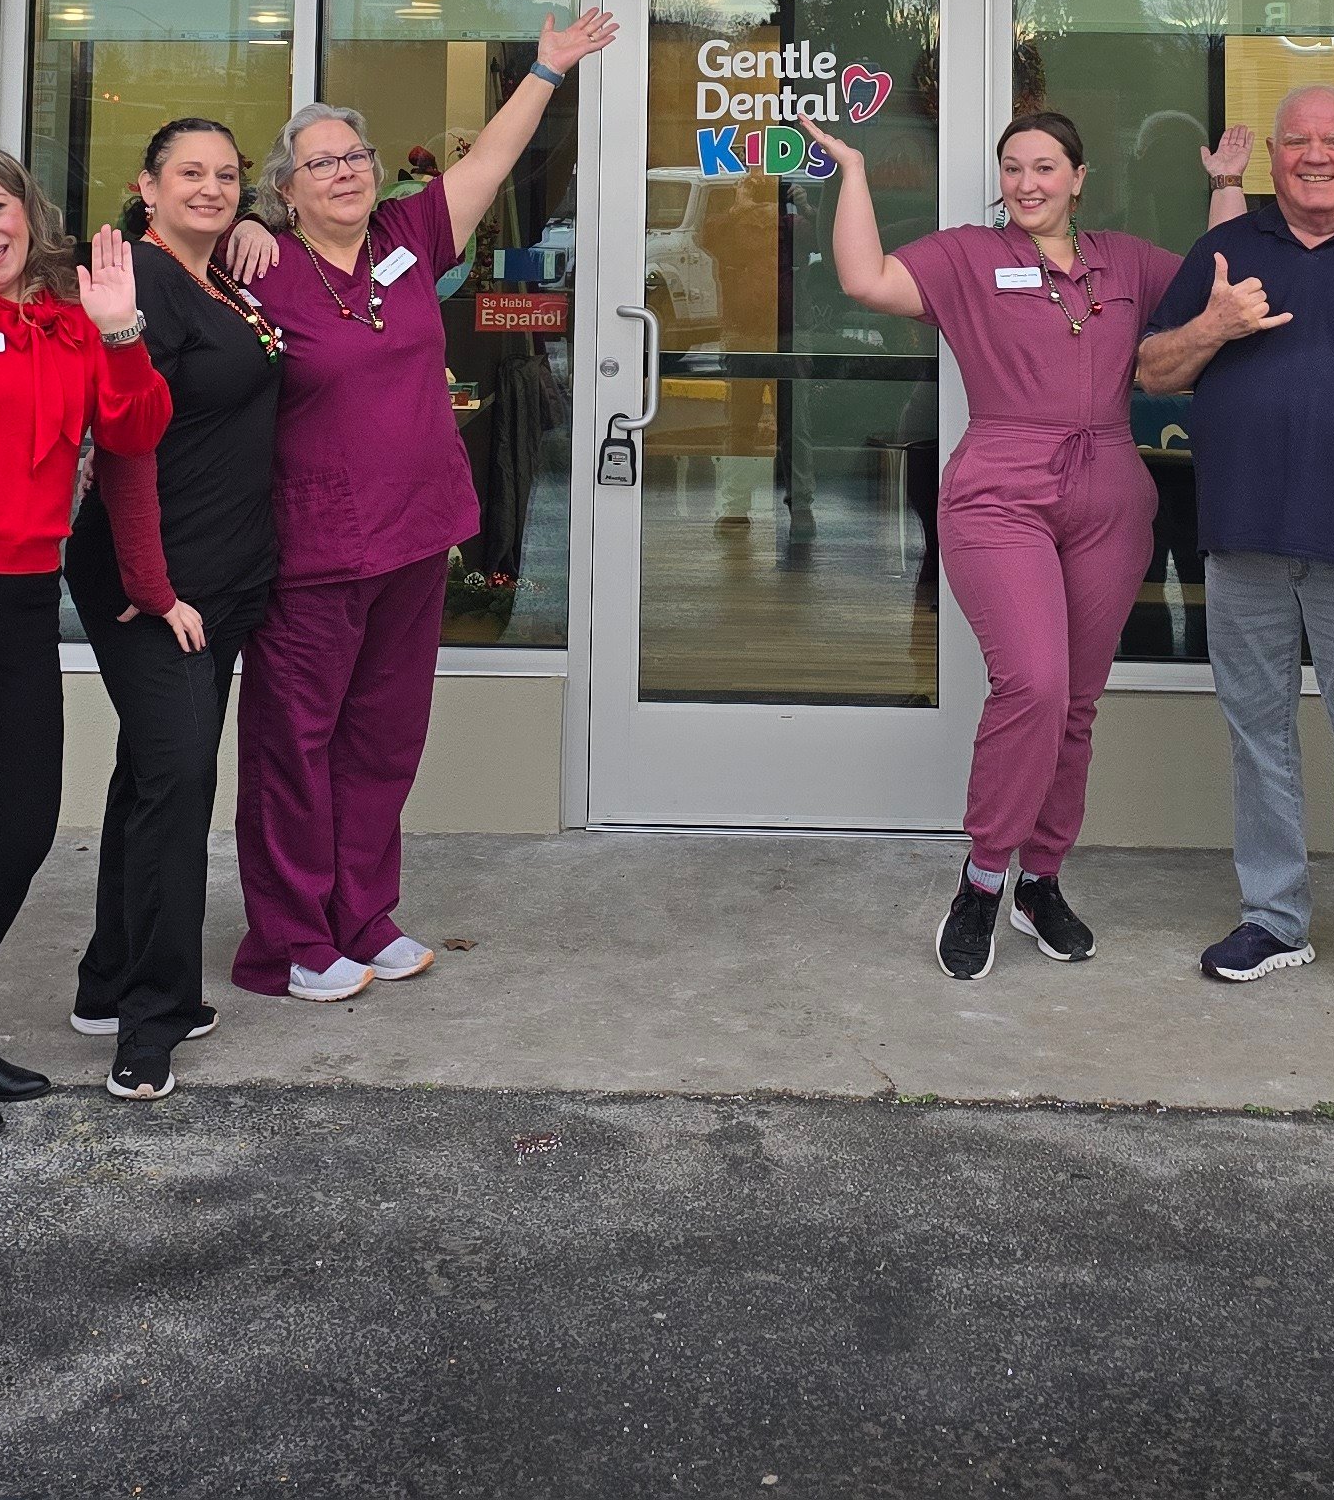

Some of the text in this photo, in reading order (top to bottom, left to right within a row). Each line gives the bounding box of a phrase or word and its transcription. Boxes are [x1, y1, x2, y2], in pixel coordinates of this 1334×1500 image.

[697, 39, 837, 79] Gentle
[696, 81, 839, 121] Dental
[482, 298, 532, 308] Se Habla
[481, 310, 561, 329] Español
